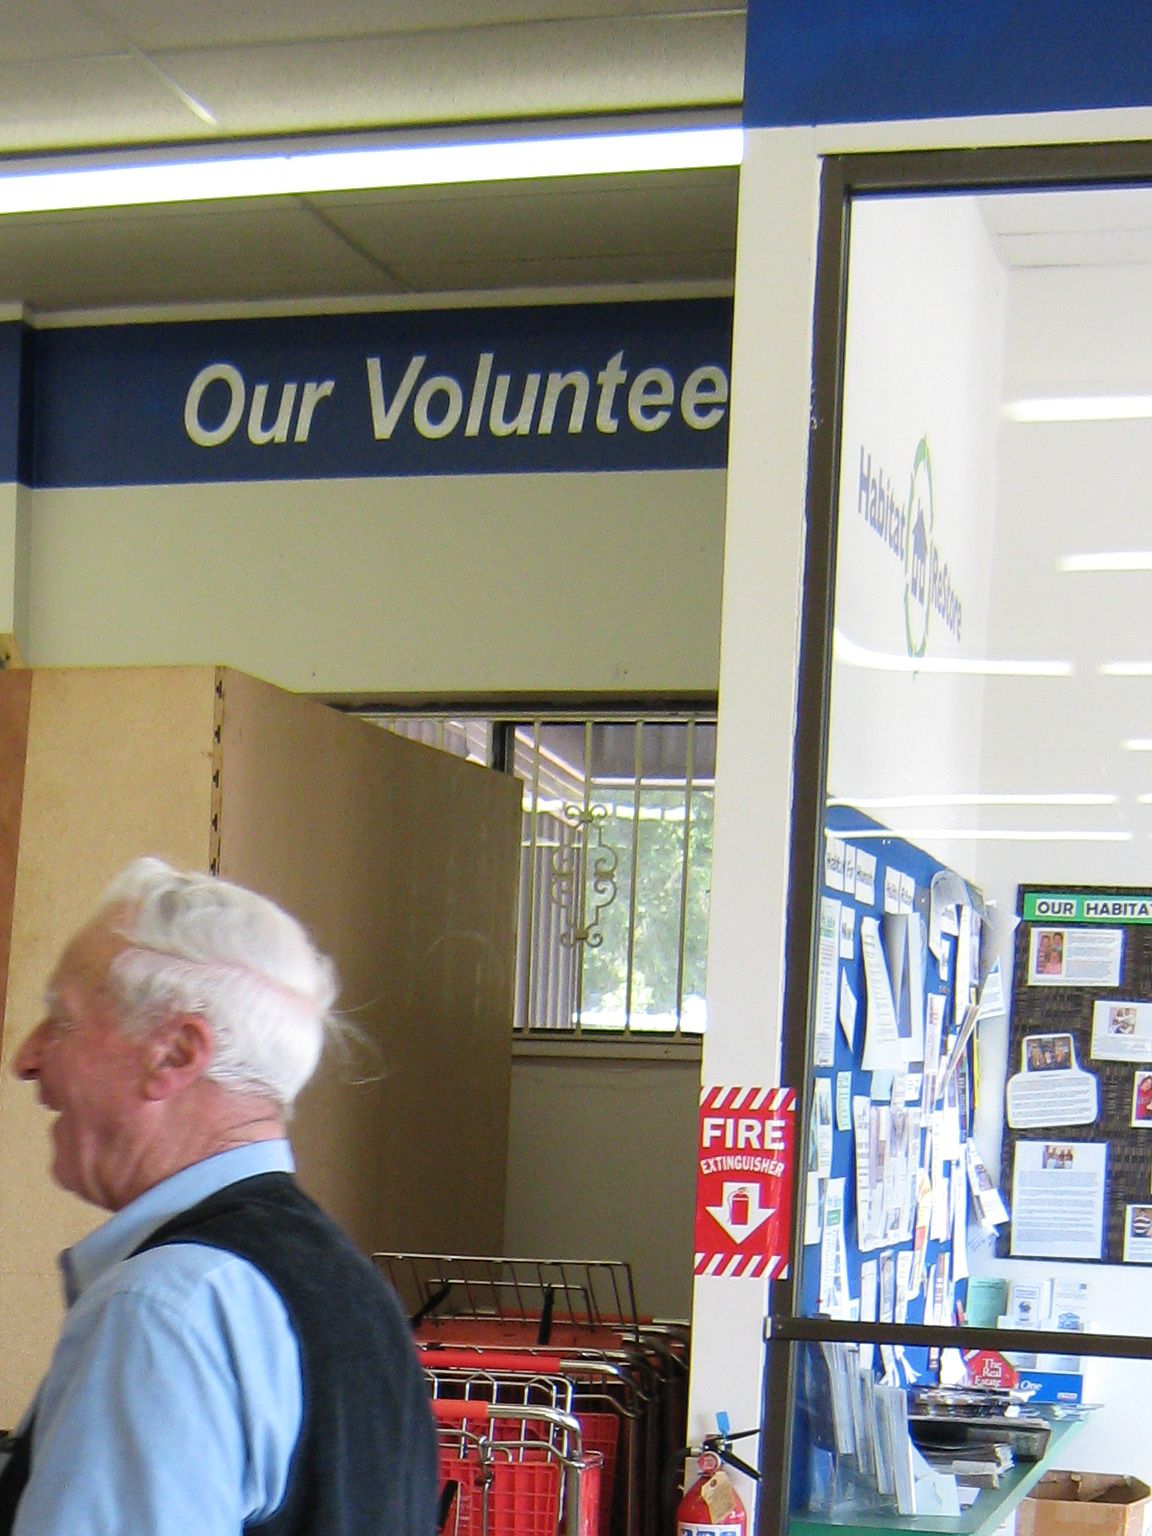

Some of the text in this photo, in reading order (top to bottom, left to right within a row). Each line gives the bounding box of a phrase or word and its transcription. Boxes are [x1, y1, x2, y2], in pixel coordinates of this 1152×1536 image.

[184, 363, 335, 447] Our
[858, 445, 905, 562] Habitat
[1038, 901, 1074, 915] OUR
[702, 1118, 786, 1150] FIRE
[700, 1155, 785, 1177] EXTINGUISHER
[982, 1367, 1002, 1378] Real
[983, 1358, 1002, 1369] The
[1020, 1380, 1043, 1391] One
